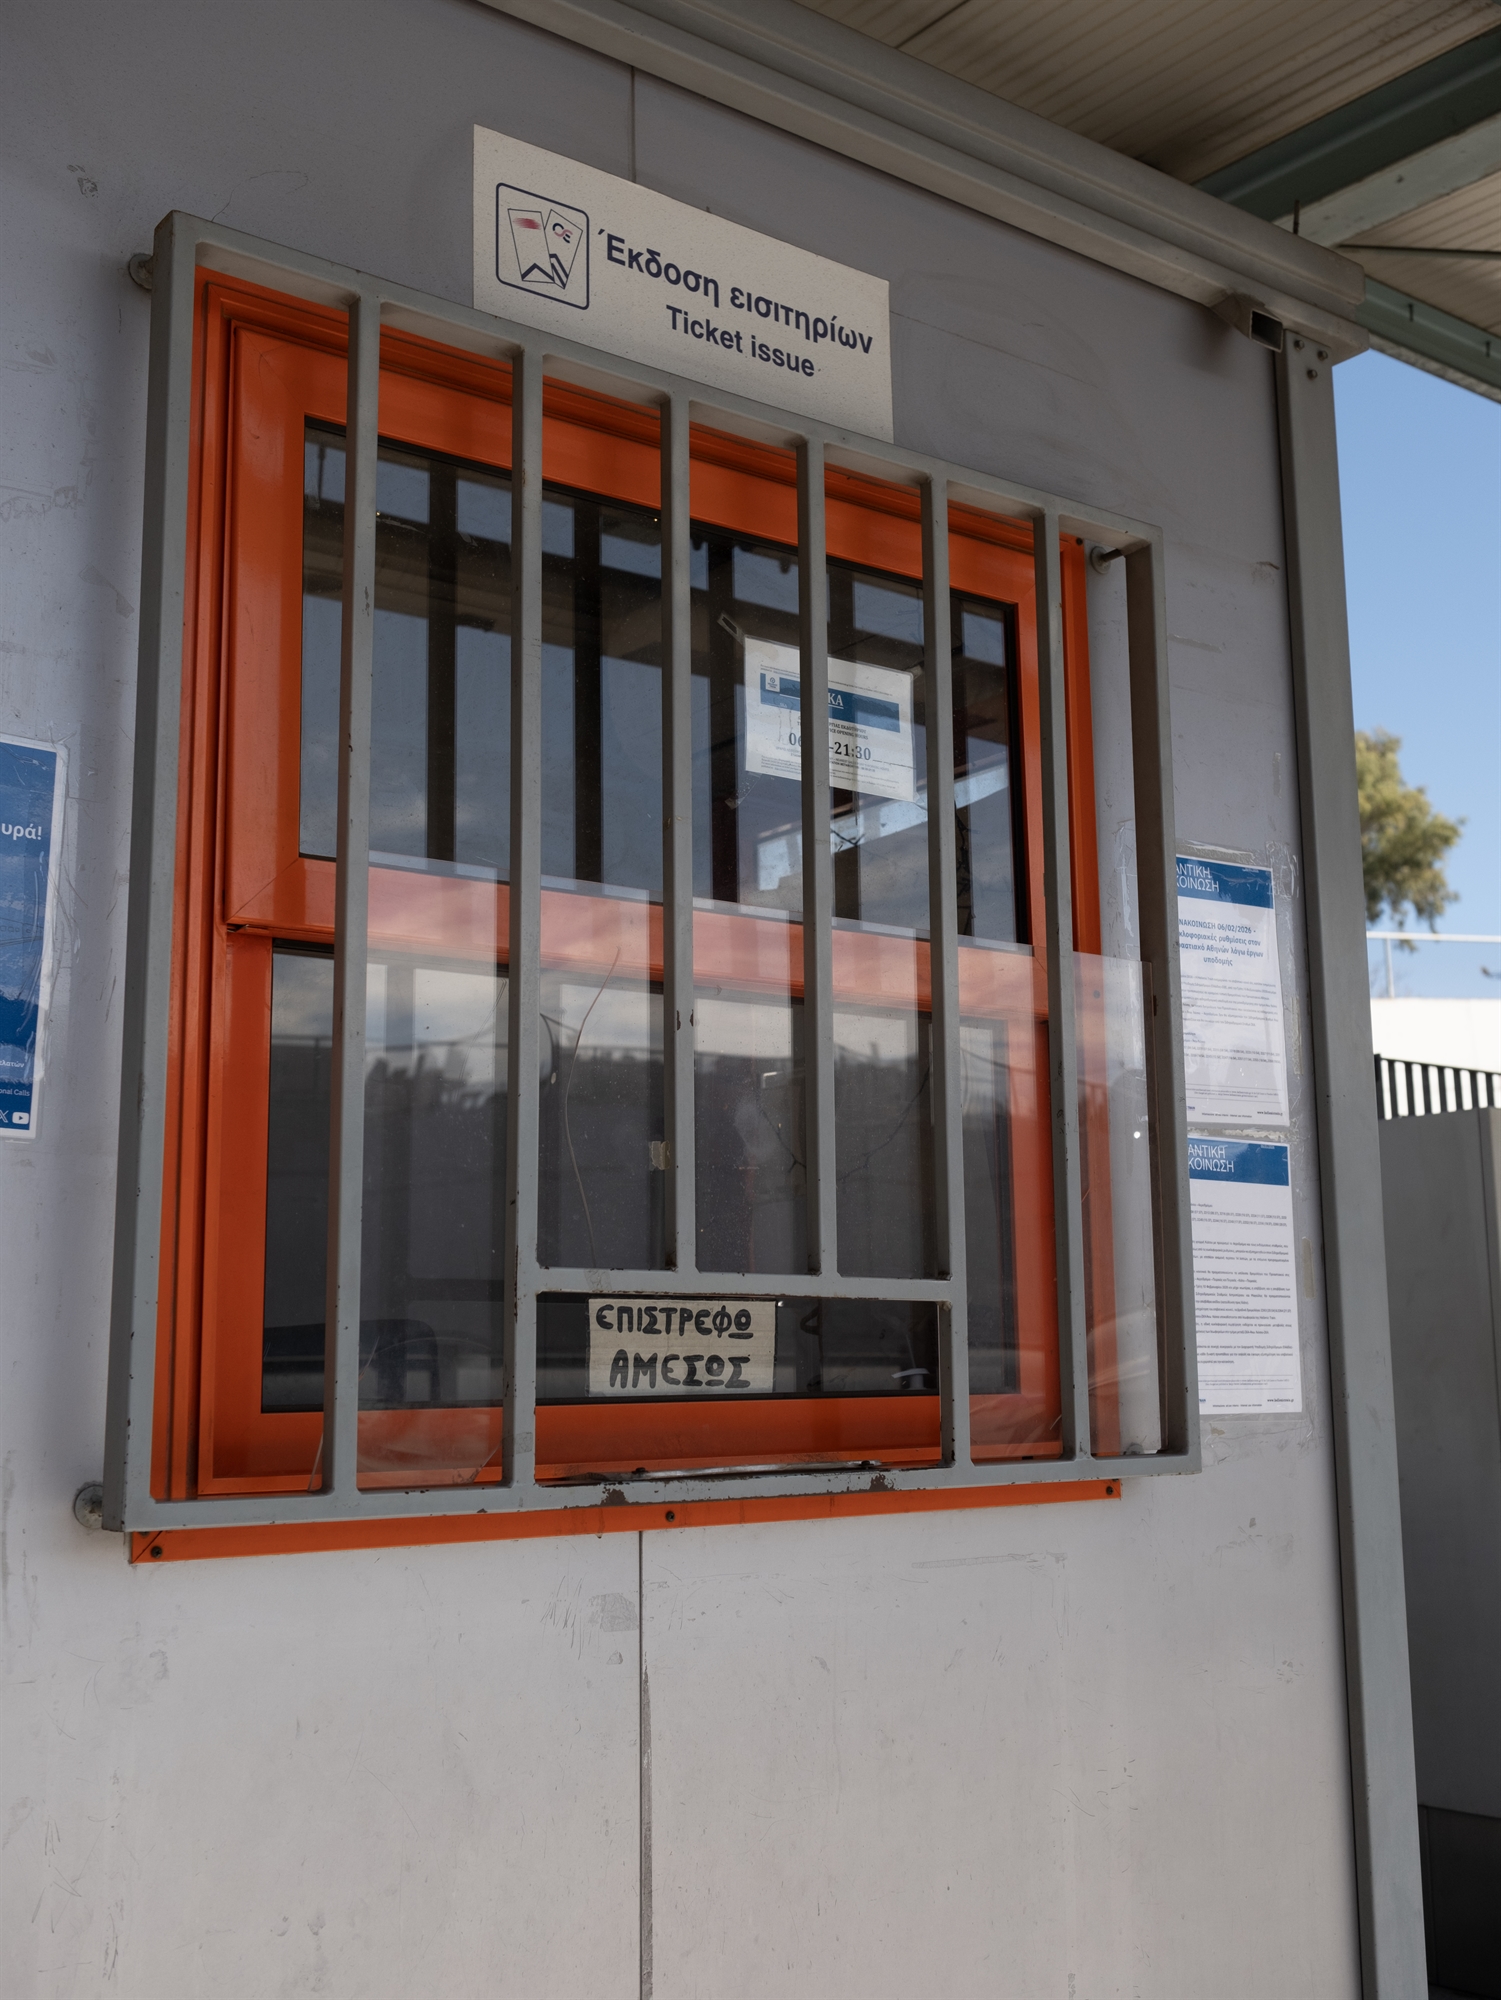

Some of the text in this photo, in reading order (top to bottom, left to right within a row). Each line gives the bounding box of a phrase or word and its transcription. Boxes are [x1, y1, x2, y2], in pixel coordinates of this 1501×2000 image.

[597, 229, 874, 355] Έκδοση εισιτηρίων
[666, 304, 816, 377] Ticket issue
[836, 730, 855, 738] OPENING
[1217, 923, 1252, 934] 06/02/2026
[13, 1088, 31, 1097] Calls
[1188, 1143, 1226, 1159] ΑΝΤΙΚΗ
